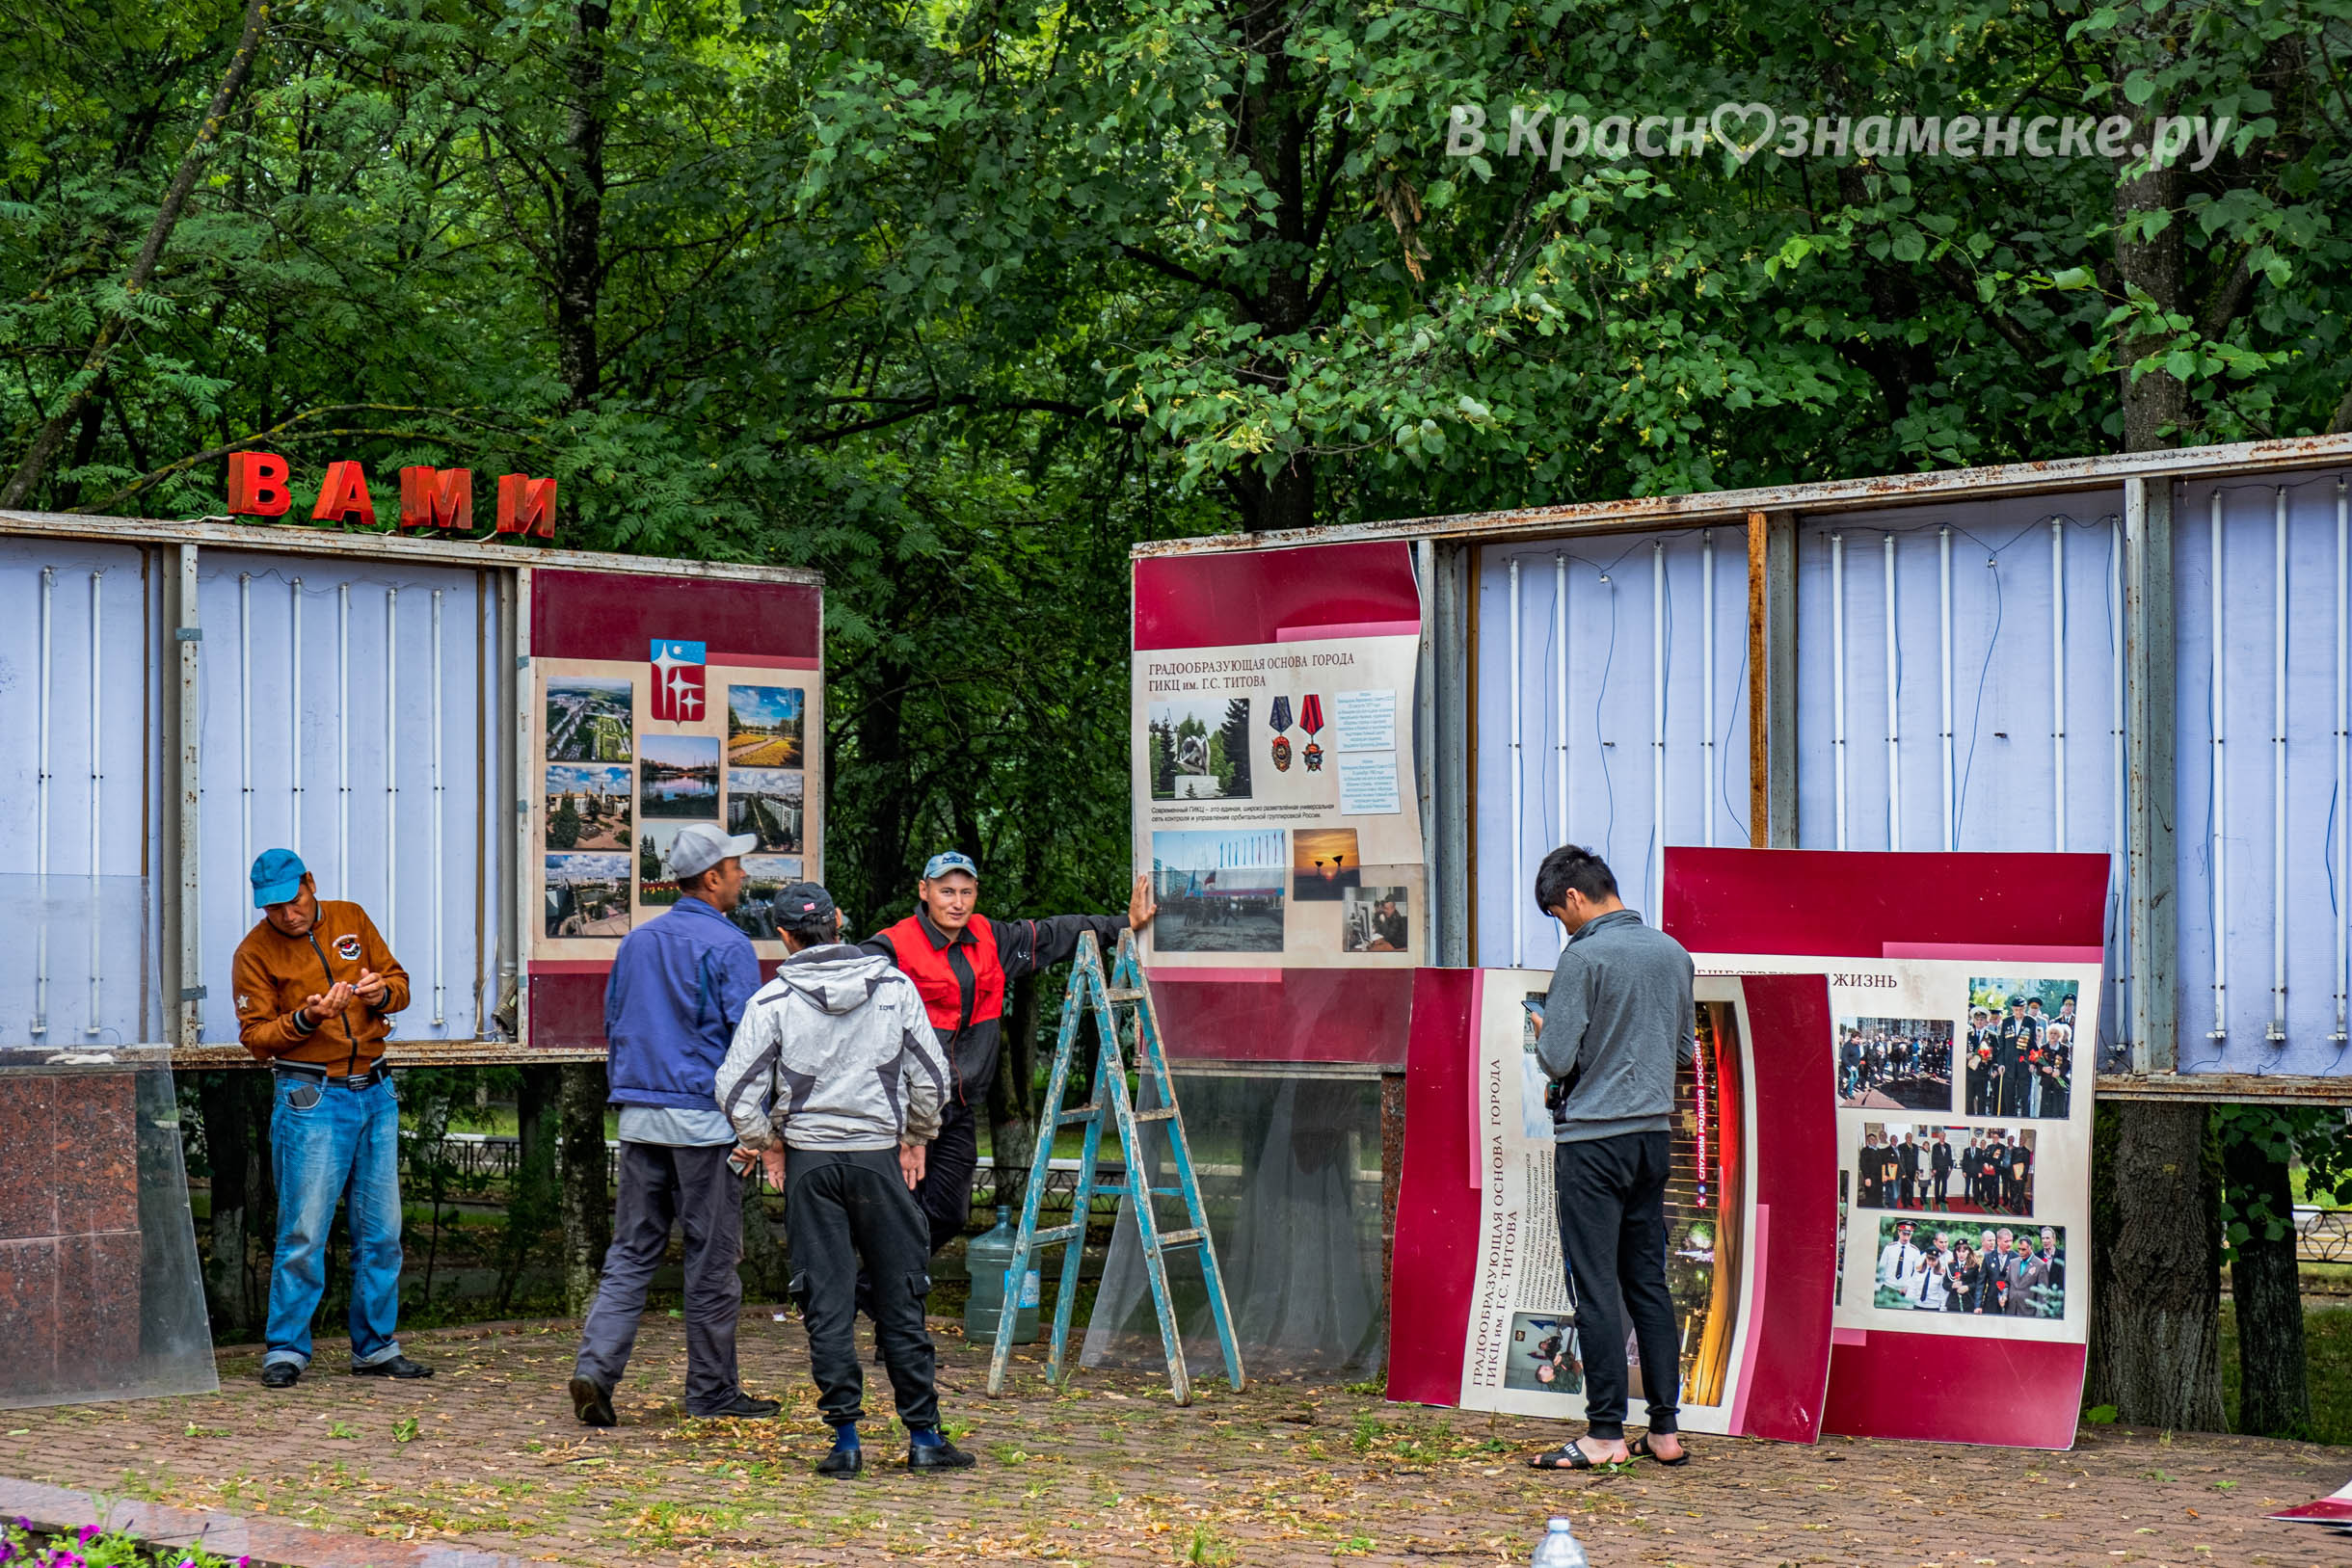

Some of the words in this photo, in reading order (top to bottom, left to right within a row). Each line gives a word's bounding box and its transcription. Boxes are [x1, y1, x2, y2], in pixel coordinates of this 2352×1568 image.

[1148, 657, 1265, 676] ГРАДООБРАЗУЮЩАЯ
[1267, 655, 1308, 670] ОСНОВА
[1312, 652, 1354, 667] ГОРОДА
[1148, 679, 1181, 693] ГИКЦ
[1182, 681, 1199, 691] им.
[1202, 678, 1220, 690] Г.С.
[1223, 675, 1267, 689] ТИТОВА
[1832, 972, 1898, 988] ЖИЗНЬ
[1695, 1040, 1704, 1087] РОССИИ!
[1490, 1059, 1502, 1126] ГОРОДА
[1697, 1089, 1706, 1133] РОДНОЙ
[1492, 1134, 1504, 1207] ОСНОВА
[1501, 1210, 1517, 1280] ТИТОВА
[1472, 1211, 1504, 1387] ГРАДООБРАЗУЮЩАЯ
[1496, 1284, 1509, 1310] Г.С.
[1514, 1256, 1527, 1308] Становление
[1495, 1315, 1504, 1337] им.
[1486, 1342, 1501, 1388] ГИКЦ
